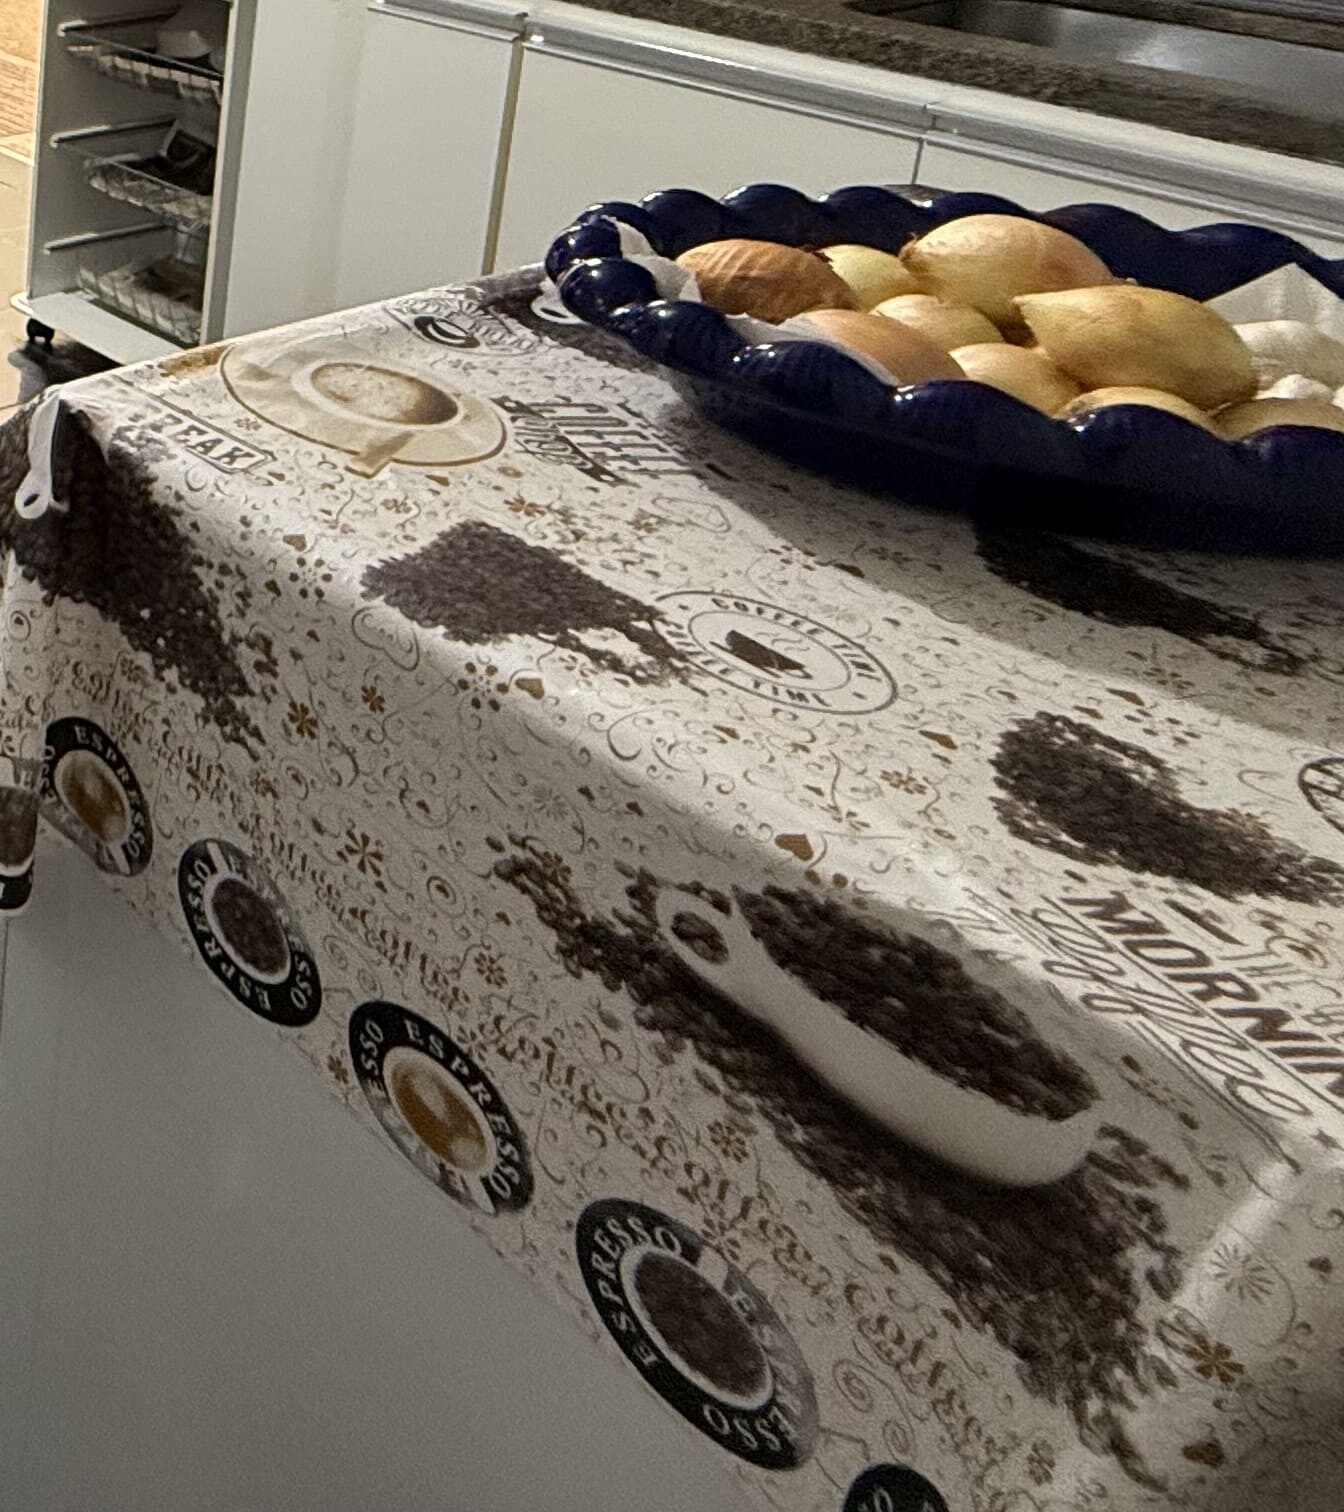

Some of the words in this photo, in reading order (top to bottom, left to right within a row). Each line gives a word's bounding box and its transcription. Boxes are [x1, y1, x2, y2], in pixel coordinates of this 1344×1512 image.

[1058, 890, 1344, 1098] MORNIN
[404, 1018, 520, 1200] ESPRESSO
[591, 1216, 681, 1366] ESPRESSO
